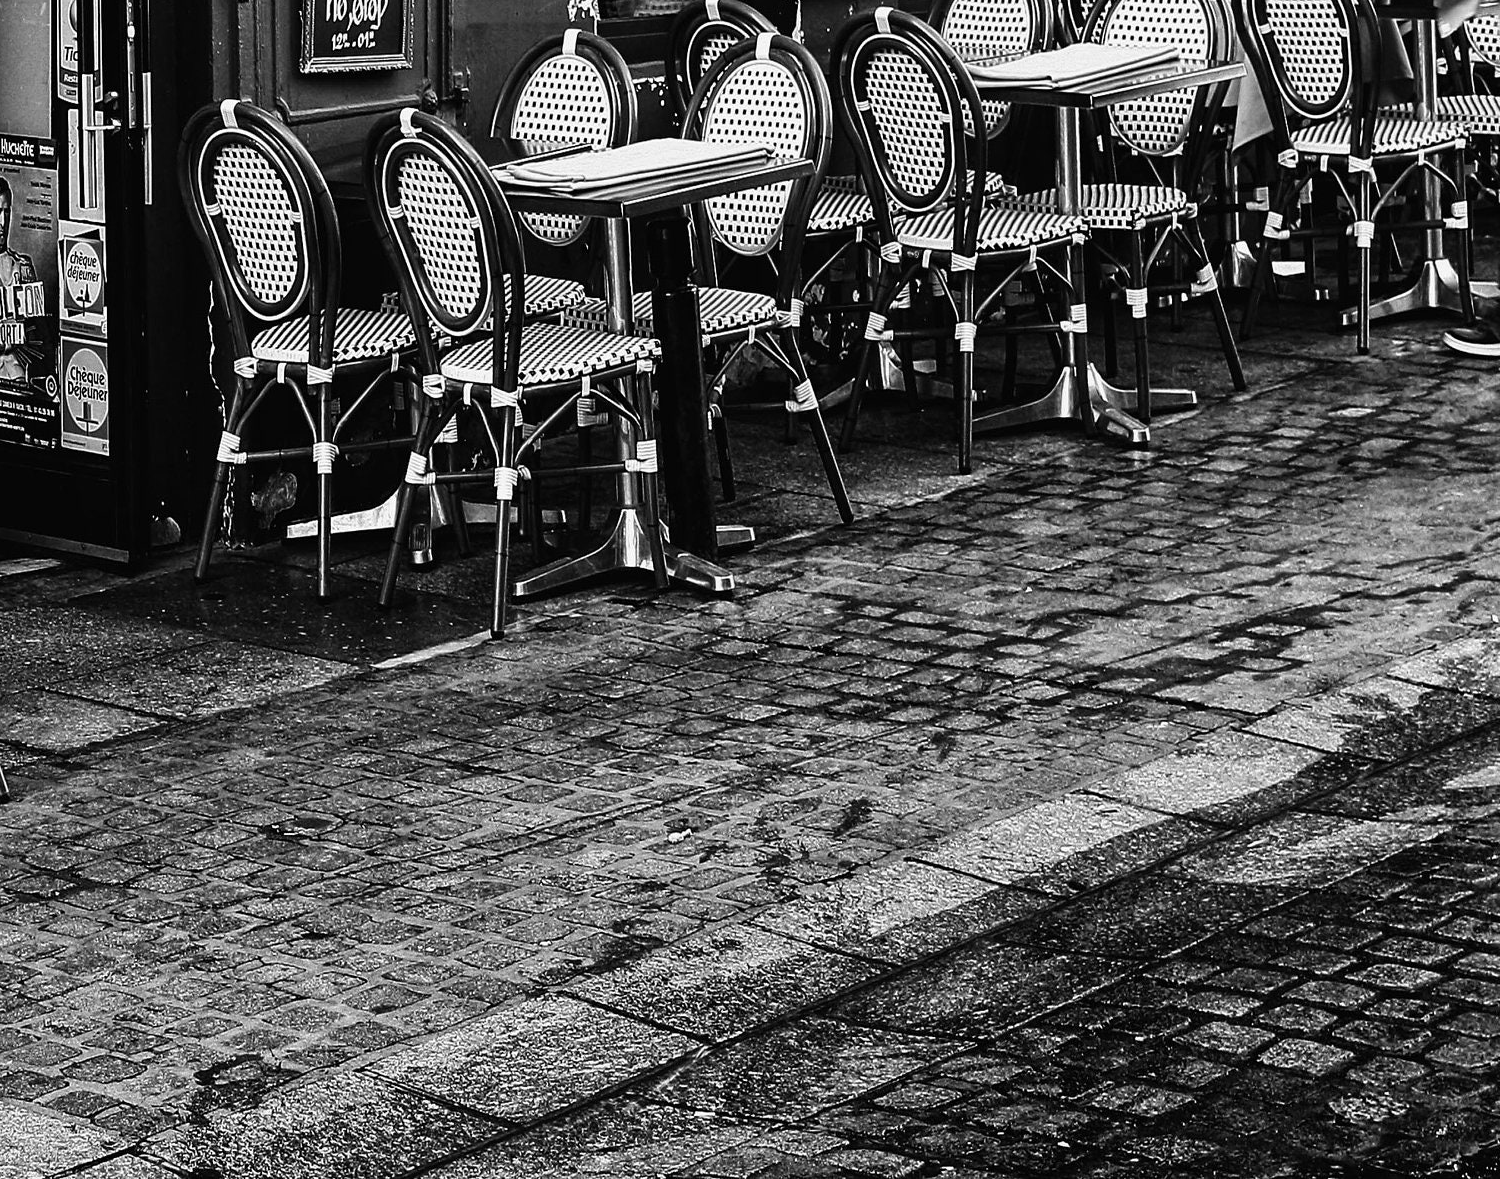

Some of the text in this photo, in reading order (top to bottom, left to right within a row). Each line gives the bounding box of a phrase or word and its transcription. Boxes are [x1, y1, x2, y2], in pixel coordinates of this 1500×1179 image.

[0, 137, 35, 158] HUCHETTE
[70, 251, 97, 269] chèque
[67, 265, 100, 283] déjeuner
[70, 366, 105, 386] Chèque
[67, 380, 108, 401] Déjeuner
